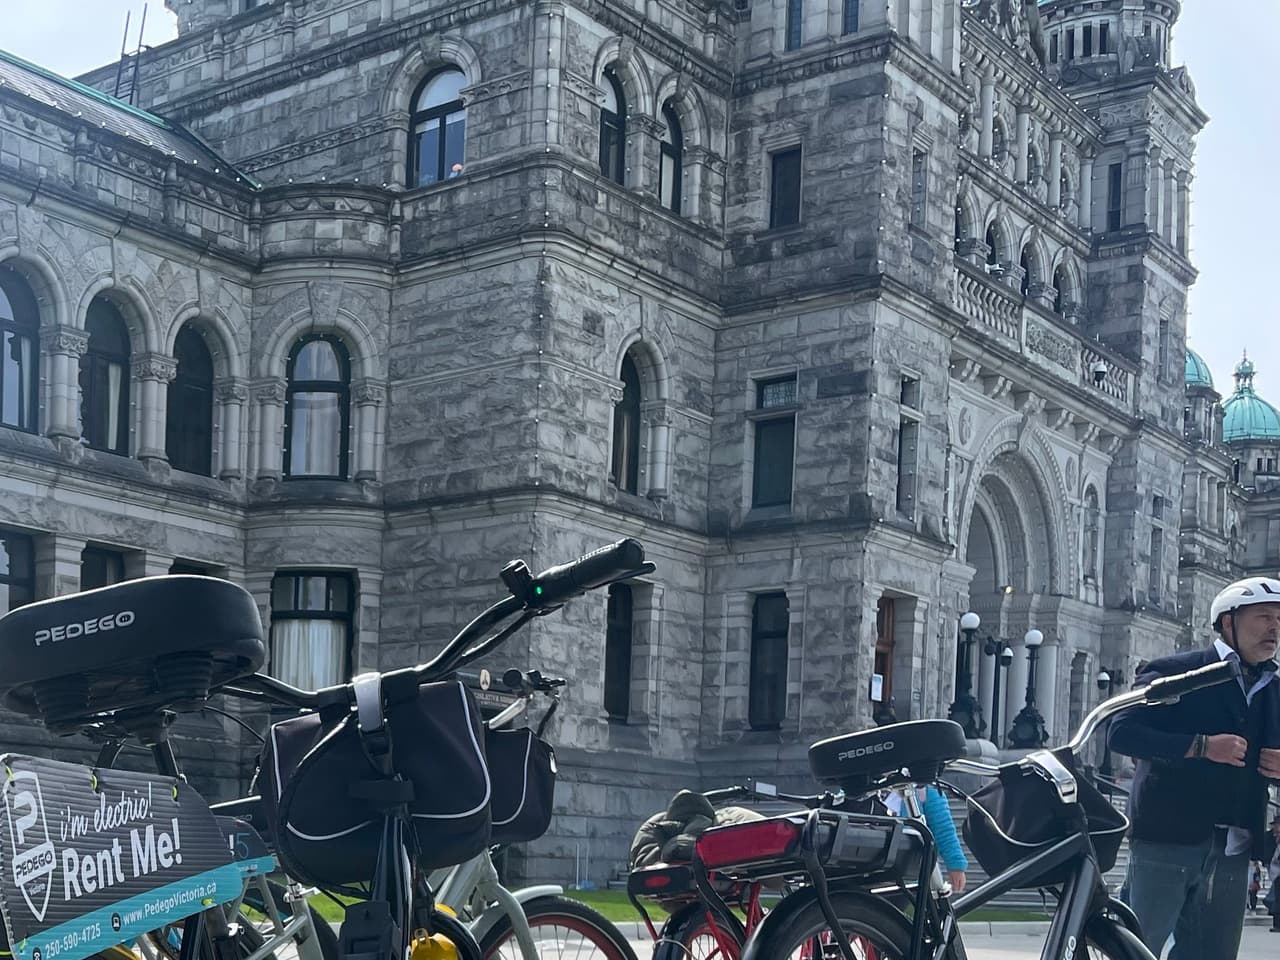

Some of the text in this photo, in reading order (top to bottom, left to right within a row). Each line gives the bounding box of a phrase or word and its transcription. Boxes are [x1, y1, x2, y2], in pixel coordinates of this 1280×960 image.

[34, 610, 136, 647] PEDEGO
[838, 741, 895, 761] PEDEGO
[60, 781, 153, 842] i'm electric!
[15, 850, 53, 880] PEDEGO
[62, 817, 182, 901] Rent Me!
[122, 880, 217, 926] www.PedegoVictoria.ca
[45, 923, 101, 959] 250-590-4725
